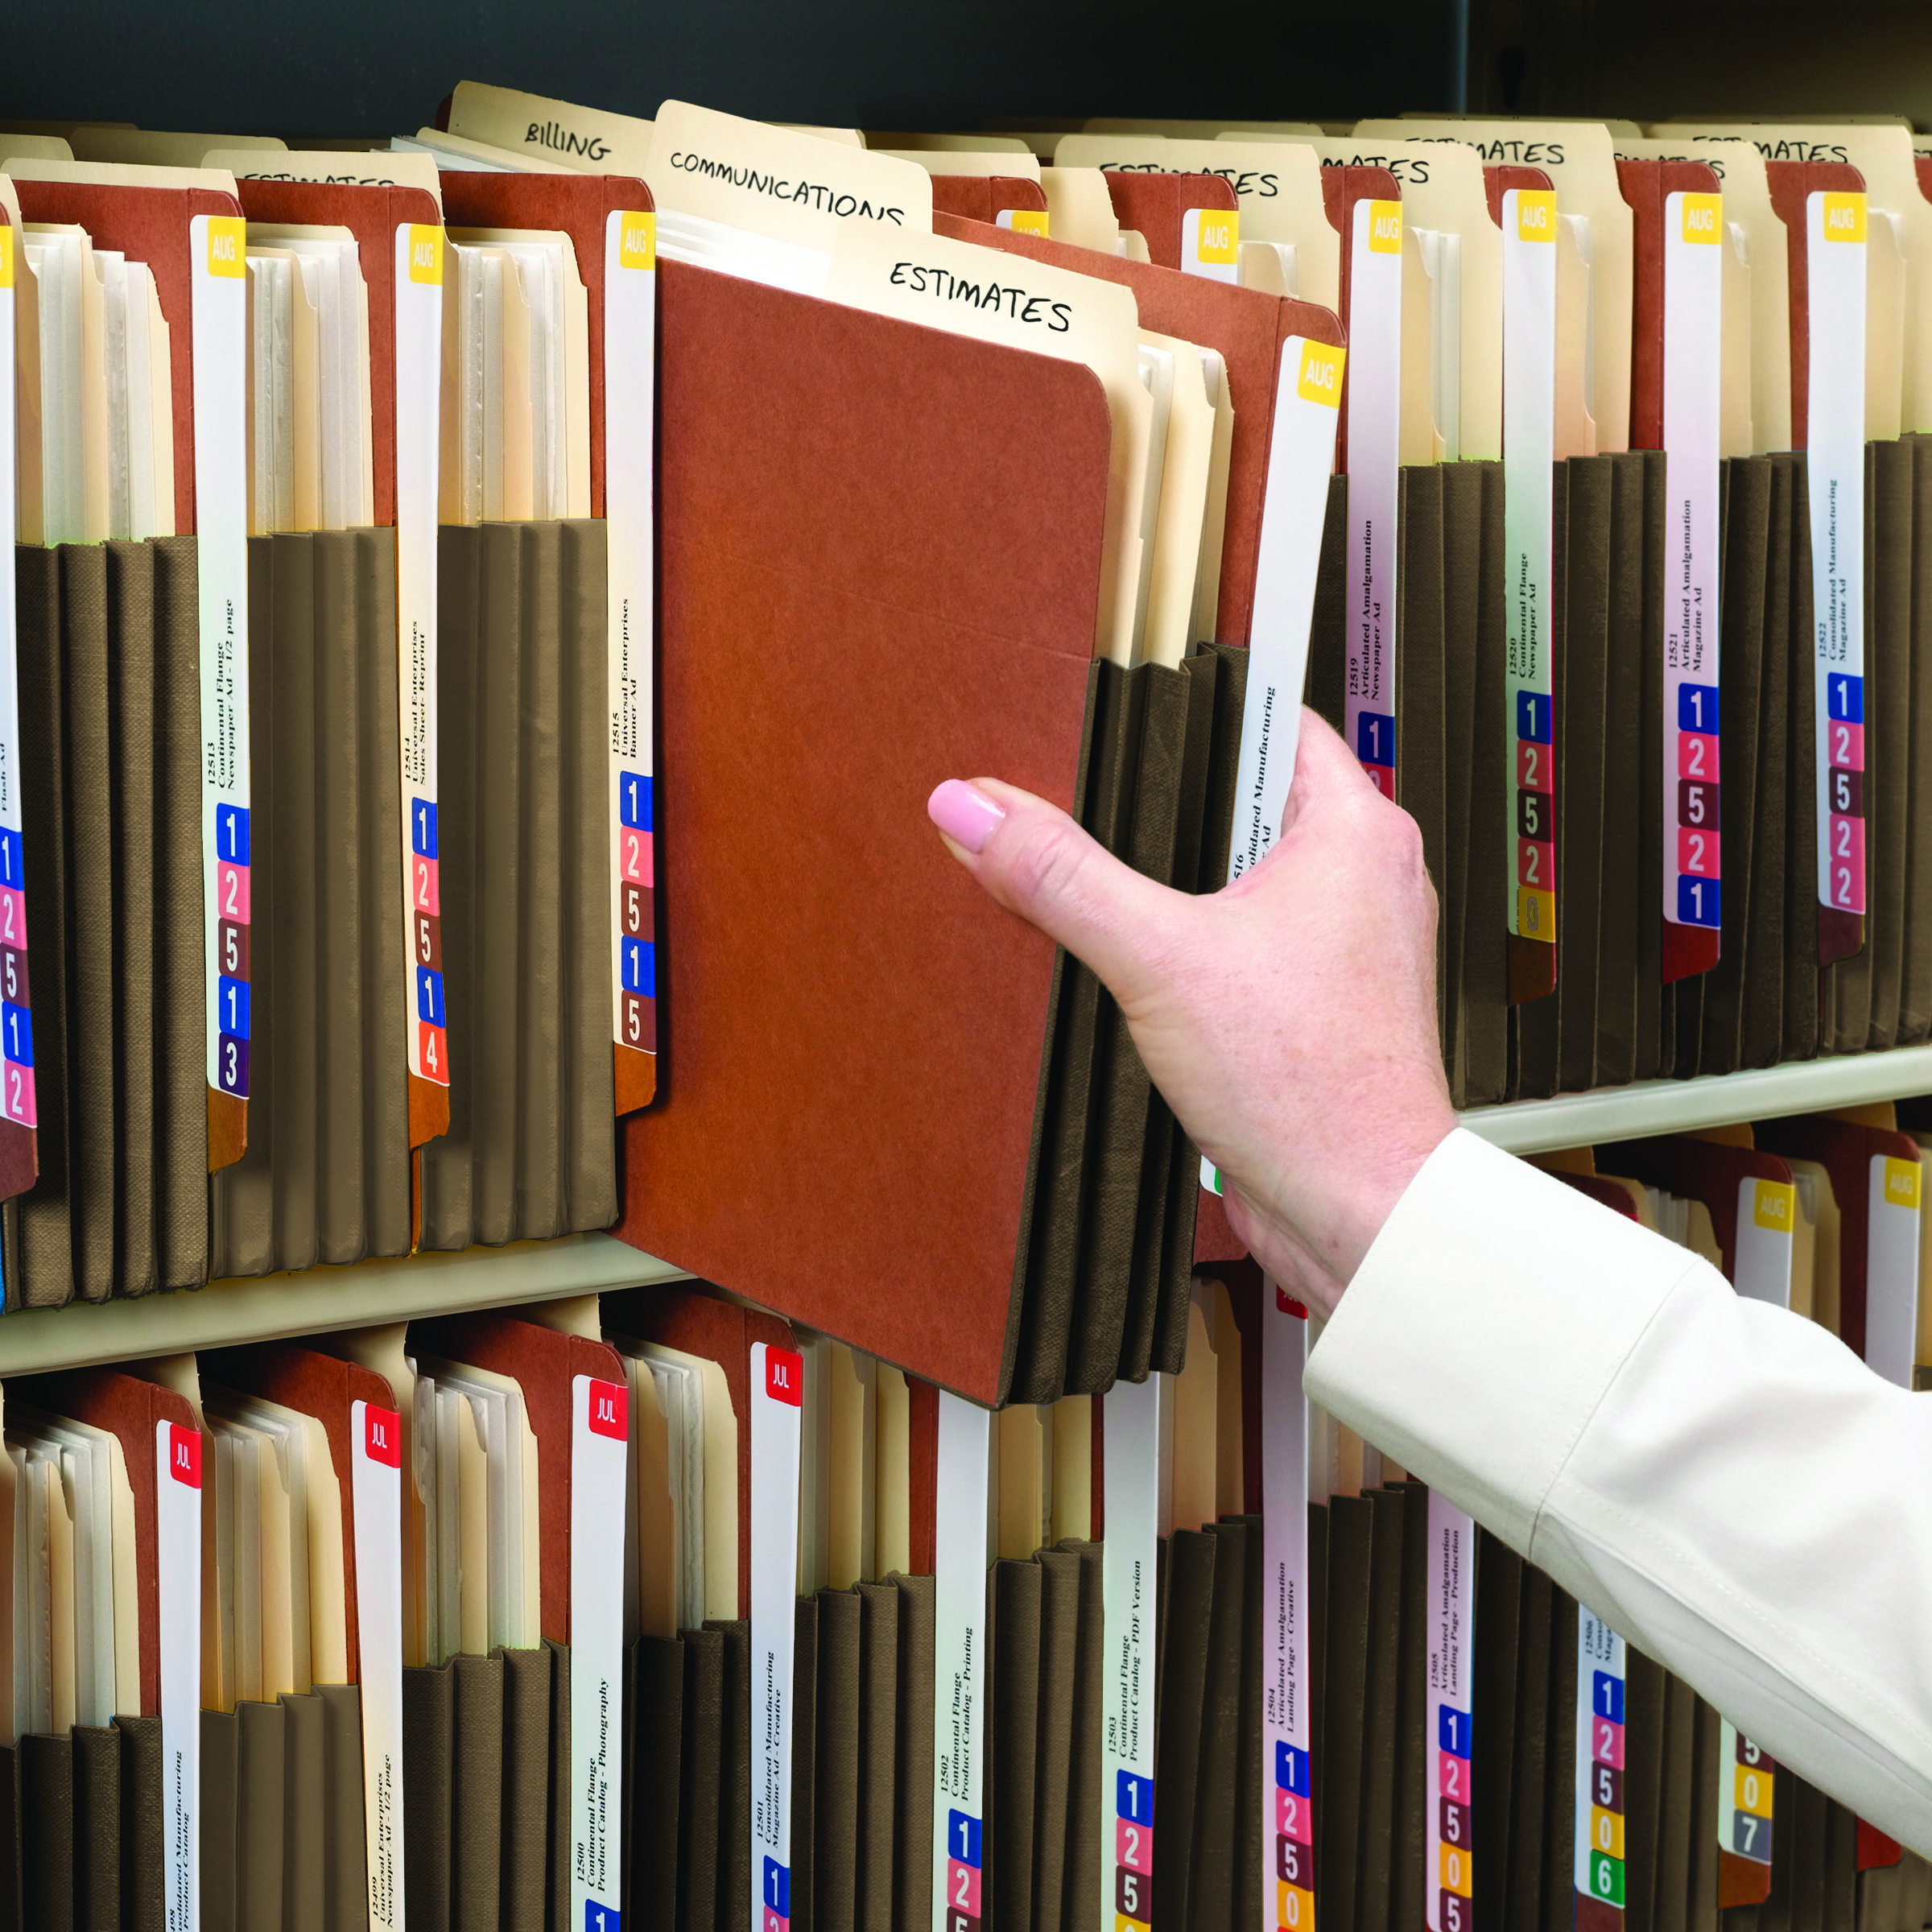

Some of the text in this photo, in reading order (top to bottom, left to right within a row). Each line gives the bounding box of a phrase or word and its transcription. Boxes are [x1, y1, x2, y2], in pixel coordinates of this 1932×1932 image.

[525, 123, 613, 162] BILLING
[1203, 226, 1228, 249] AUG
[1375, 217, 1399, 239] AUG
[1522, 206, 1546, 228] AUG
[1687, 209, 1713, 230] AUG
[1829, 208, 1855, 229] AUG
[213, 235, 235, 261] AUG
[414, 242, 434, 267] AUG
[624, 227, 646, 254] AUG
[890, 262, 1073, 332] ESTIMATES
[1304, 358, 1335, 390] AUG
[1828, 480, 1837, 575] Manufacturing
[1520, 553, 1528, 597] Flange
[1682, 500, 1692, 671] Articulated Amalgamation
[226, 599, 234, 635] page
[1361, 520, 1373, 700] Articulated Amalgamation
[1694, 588, 1703, 672] Magazine Ad
[1839, 579, 1847, 662] Magazine Ad
[621, 599, 630, 682] Enterprises
[1372, 602, 1381, 700] Newspaper Ad
[1529, 584, 1537, 679] Newspaper Ad
[1670, 634, 1678, 668] 12521
[226, 679, 233, 700] Ad
[630, 679, 637, 700] Ad
[1350, 658, 1359, 696] 12519
[217, 642, 225, 788] Continental Flange
[228, 705, 236, 791] Newspaper
[1254, 687, 1275, 801] Manufacturing
[1261, 826, 1271, 848] Ad
[1889, 1172, 1913, 1195] AUG
[1761, 1195, 1785, 1218] AUG
[773, 1363, 790, 1389] JUL
[597, 1397, 616, 1424] JUL
[372, 1422, 388, 1449] JUL
[176, 1442, 191, 1471] JUL
[1133, 1561, 1141, 1609] Version
[1442, 1529, 1450, 1620] Amalgamation
[1278, 1562, 1286, 1654] Amalgamation
[1450, 1612, 1459, 1641] Page
[964, 1627, 972, 1682] Printing
[1287, 1647, 1295, 1676] Page
[1450, 1645, 1458, 1696] Landing
[1119, 1635, 1129, 1758] Continental Flange
[1129, 1655, 1141, 1706] Catalog
[766, 1651, 774, 1752] Manufacturing
[963, 1693, 972, 1744] Catalog
[598, 1678, 609, 1767] Photography
[951, 1673, 962, 1797] Continental Flange
[1108, 1716, 1117, 1753] 12503
[1129, 1710, 1137, 1761] Product
[774, 1761, 780, 1781] Ad
[940, 1755, 949, 1793] 12502
[961, 1748, 969, 1802] Product
[588, 1757, 597, 1888] Continental Flange
[597, 1781, 608, 1834] Catalog
[386, 1826, 391, 1847] Ad
[577, 1843, 585, 1882] 12500
[597, 1838, 605, 1892] Product
